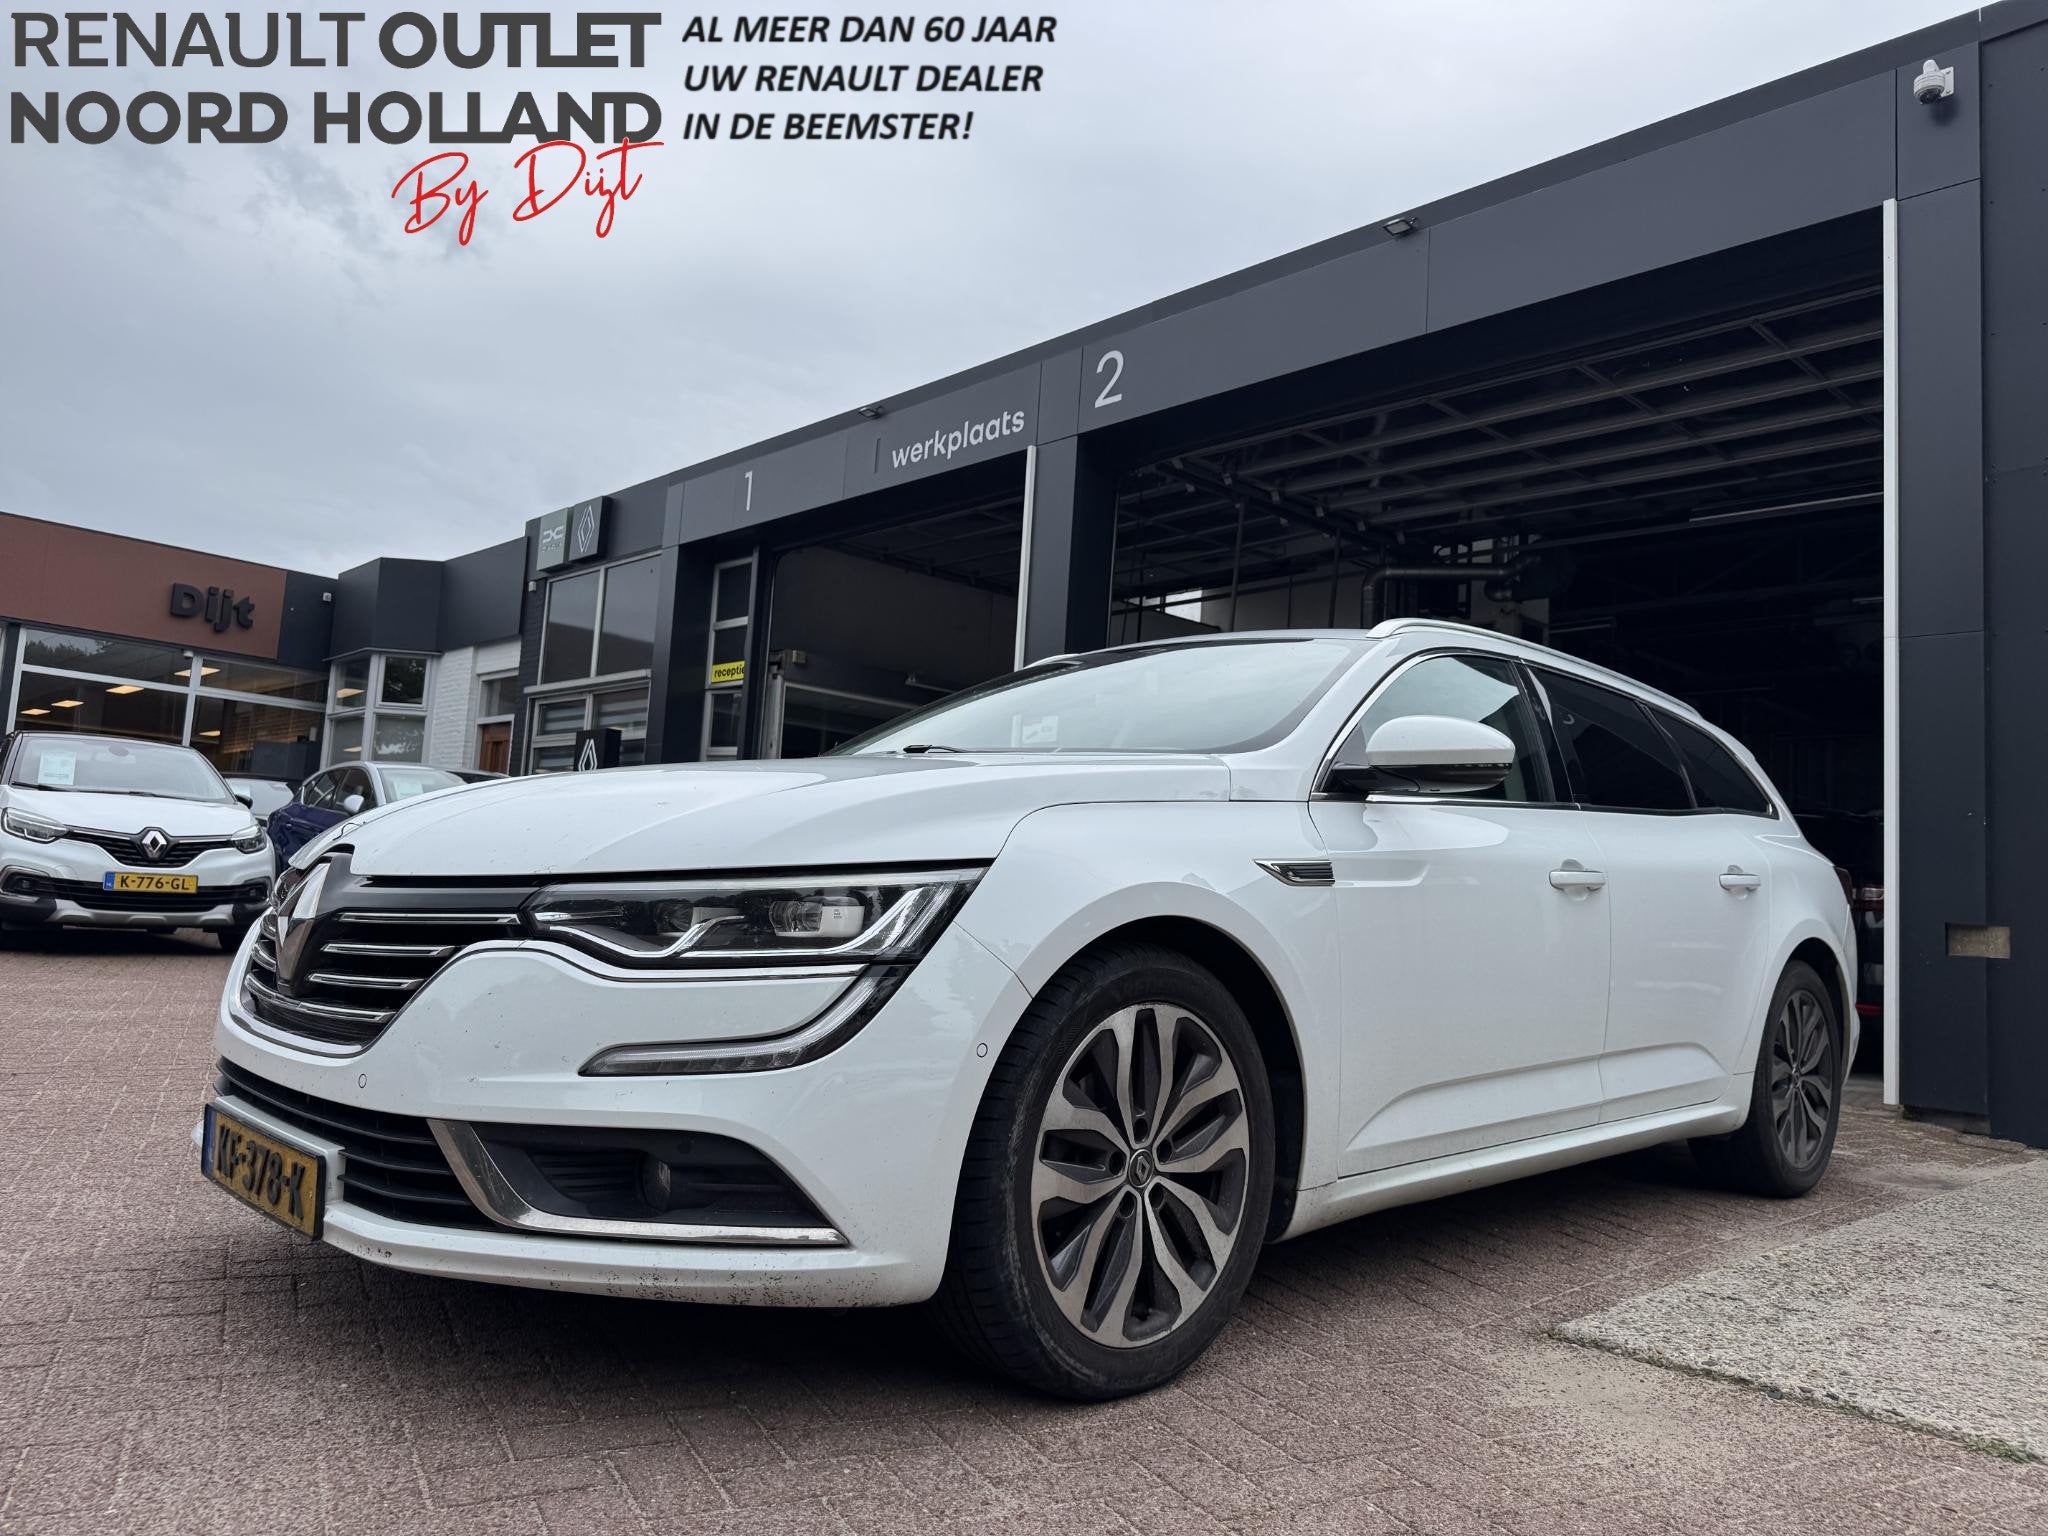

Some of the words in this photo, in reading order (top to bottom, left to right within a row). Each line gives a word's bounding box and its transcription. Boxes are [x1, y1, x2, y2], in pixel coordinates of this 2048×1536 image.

[1094, 350, 1125, 409] 2
[891, 409, 1026, 468] werkplaats
[744, 470, 754, 511] 1
[169, 582, 256, 633] Dijt
[119, 875, 190, 891] K-776-GL
